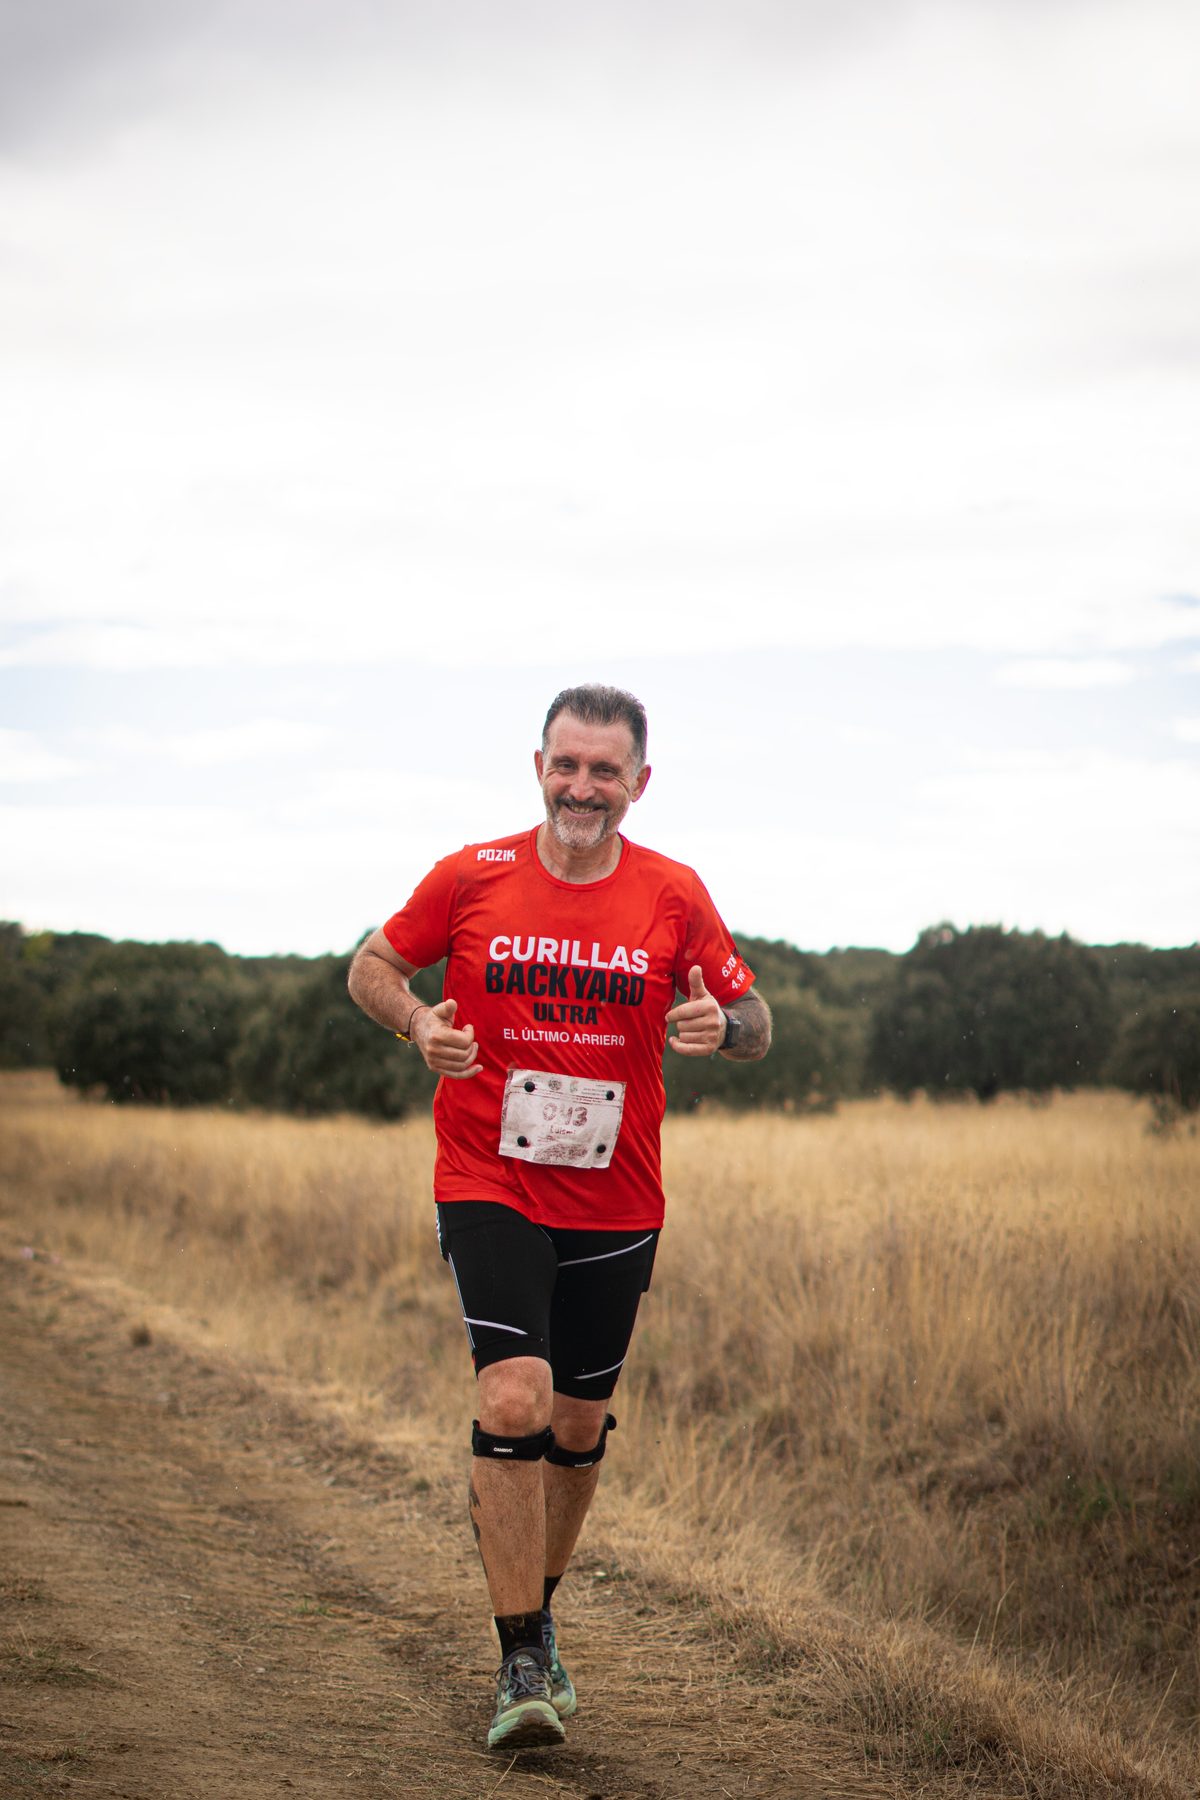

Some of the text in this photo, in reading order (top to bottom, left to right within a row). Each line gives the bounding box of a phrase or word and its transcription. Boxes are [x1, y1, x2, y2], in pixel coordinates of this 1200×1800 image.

[489, 935, 649, 975] CURILLAS
[485, 962, 646, 1007] BACKYARD
[533, 1002, 598, 1025] ULTRA
[503, 1027, 625, 1047] EL ÚLTIMO ARRIERO
[543, 1102, 588, 1127] 043
